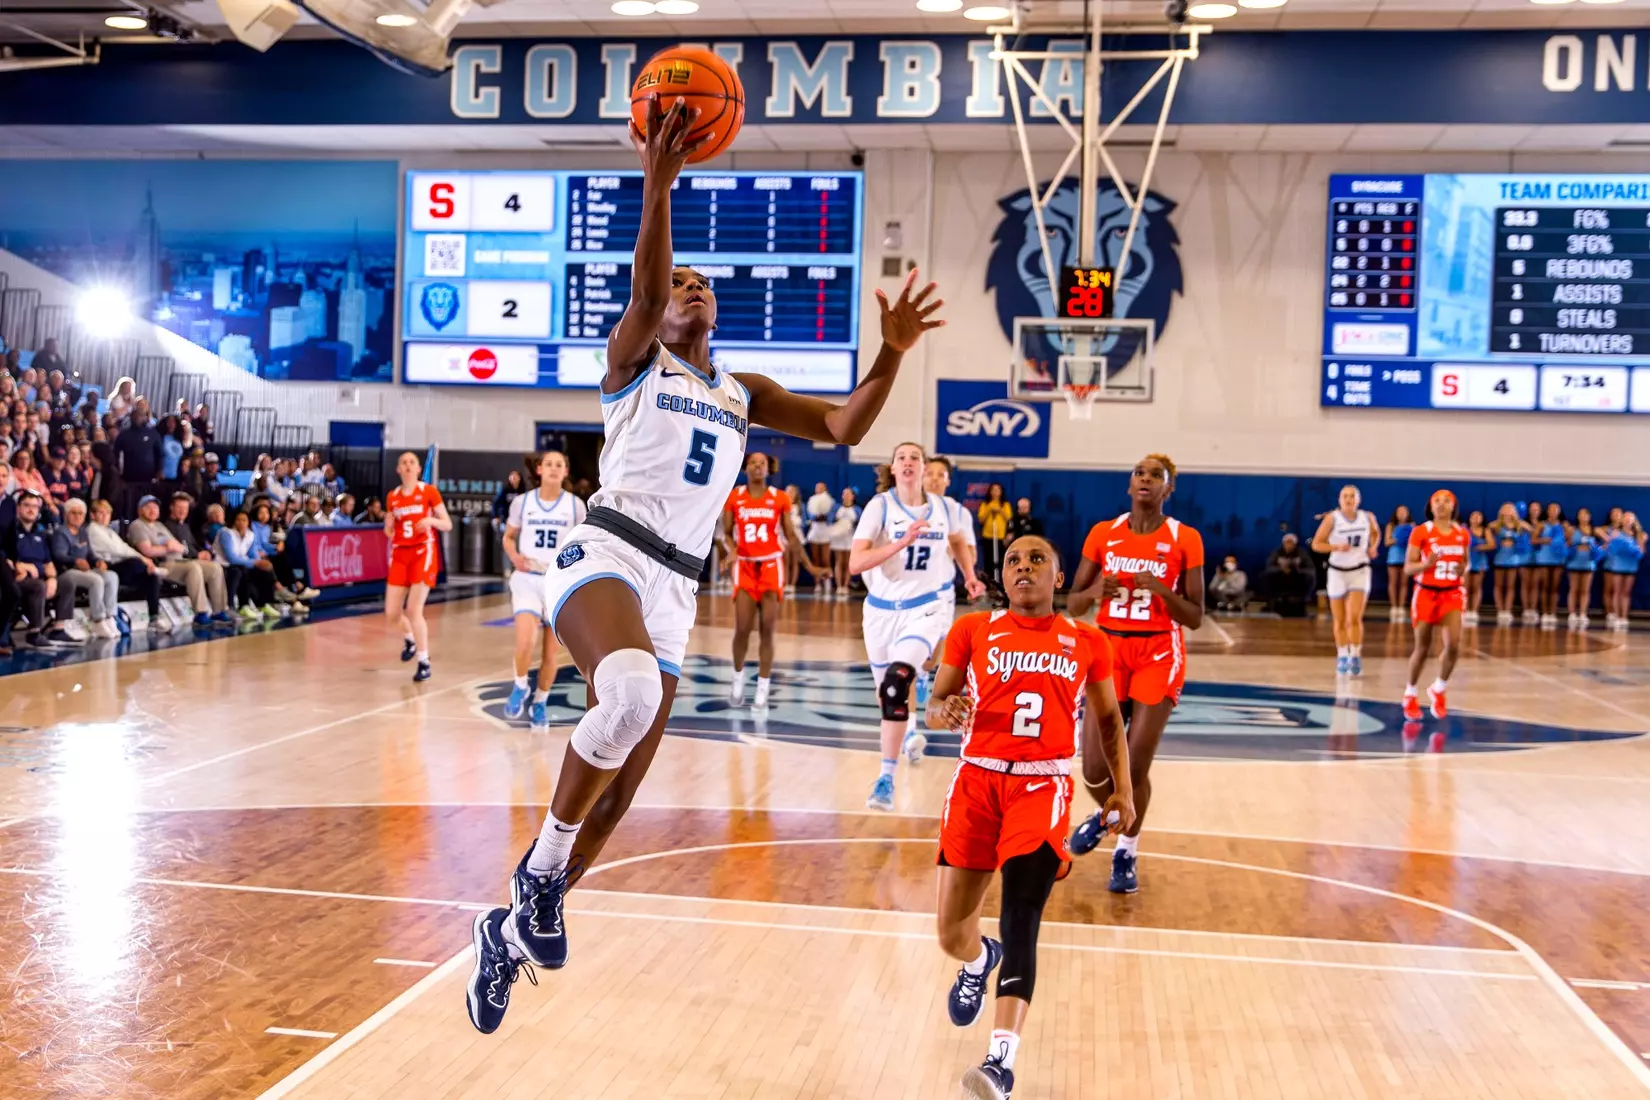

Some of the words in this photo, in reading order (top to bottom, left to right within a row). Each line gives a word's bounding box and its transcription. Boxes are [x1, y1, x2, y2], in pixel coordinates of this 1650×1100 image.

[1542, 34, 1650, 91] ON
[429, 182, 455, 218] S
[1500, 183, 1551, 200] TEAM
[504, 194, 522, 212] 4
[1546, 259, 1633, 279] REBOUNDS
[1067, 286, 1103, 317] 28
[1552, 284, 1623, 304] ASSISTS
[502, 299, 518, 318] 2
[1556, 308, 1618, 329] STEALS
[1538, 332, 1634, 354] TURNOVERS
[1442, 374, 1458, 396] S
[1493, 379, 1510, 394] 4
[1562, 374, 1605, 389] 7:34
[946, 407, 1027, 437] SNY
[682, 427, 719, 486] 5
[448, 499, 492, 510] LIONS
[402, 520, 413, 538] 5
[535, 530, 557, 548] 35
[744, 523, 769, 543] 24
[904, 545, 930, 571] 12
[1105, 551, 1168, 578] Syracuse
[1434, 560, 1458, 580] 25
[1108, 586, 1152, 620] 22
[986, 646, 1078, 683] Syracuse
[1011, 691, 1044, 738] 2
